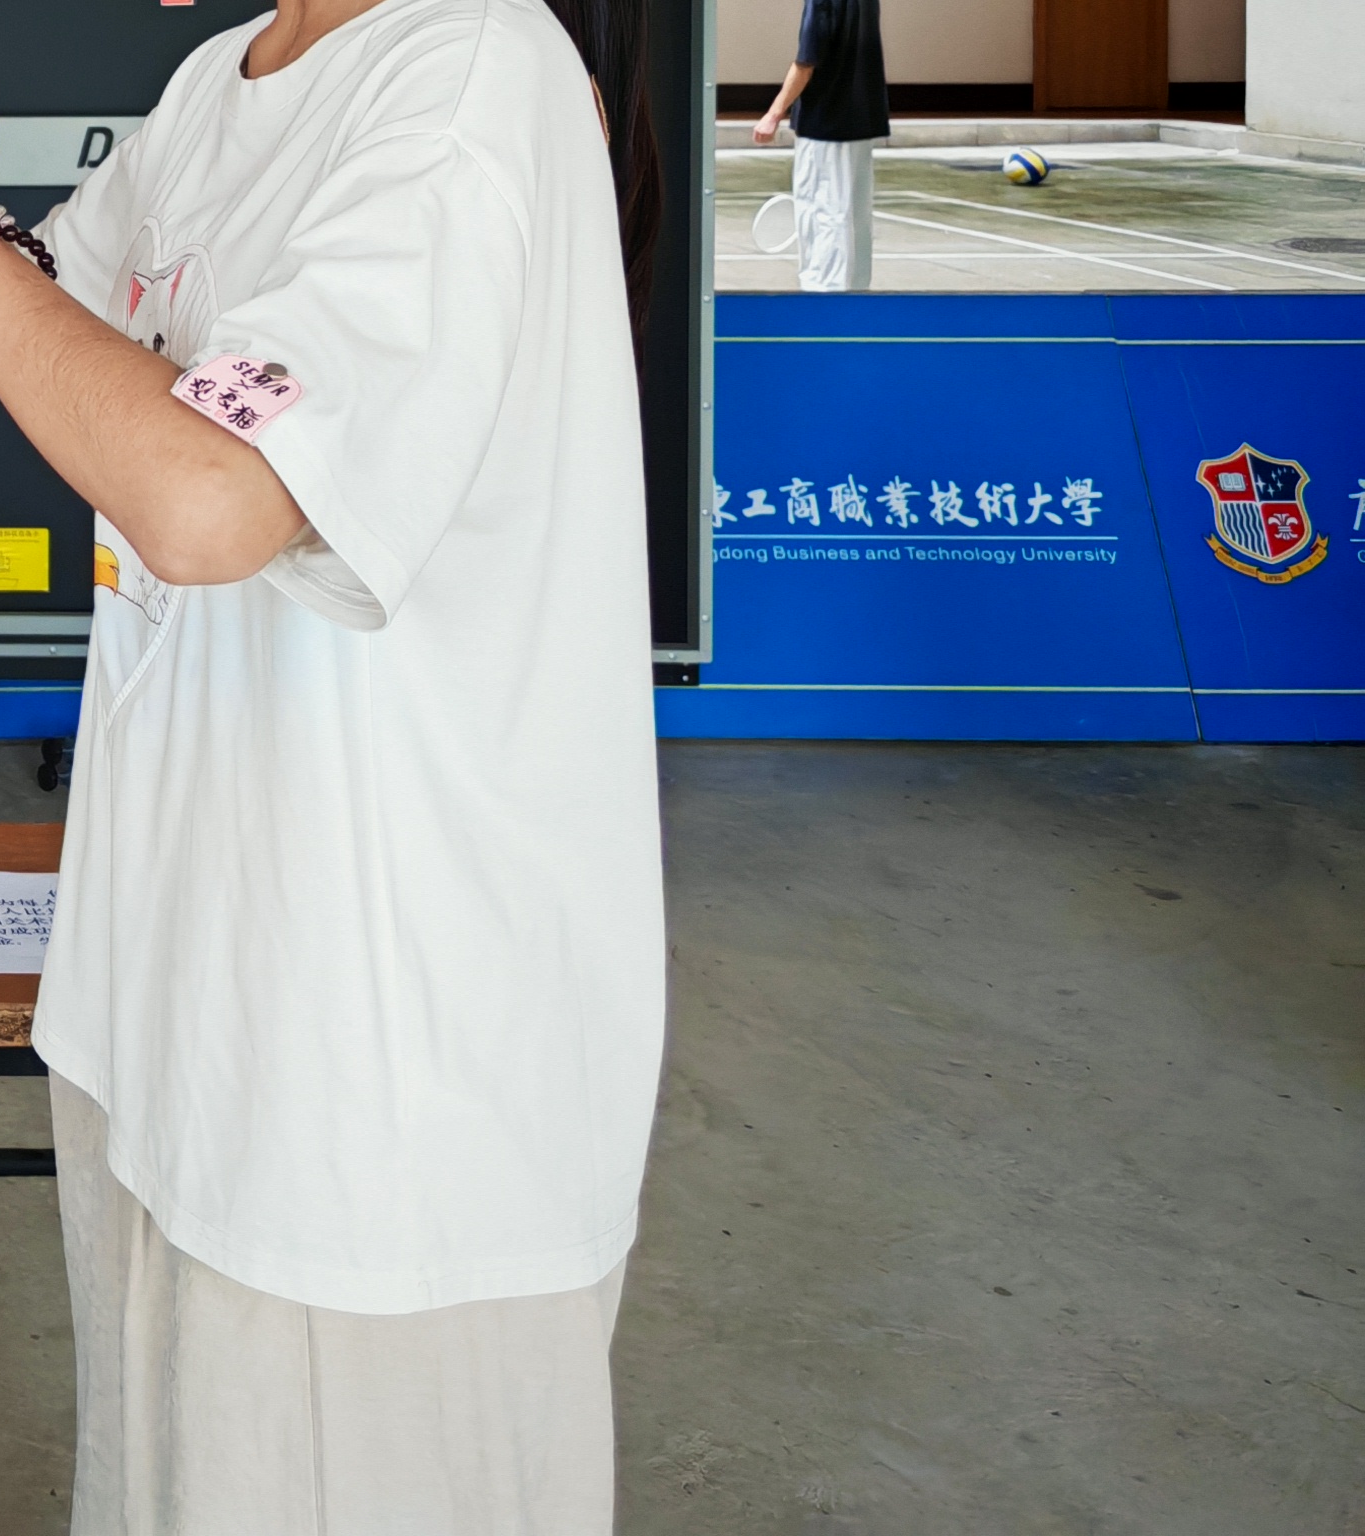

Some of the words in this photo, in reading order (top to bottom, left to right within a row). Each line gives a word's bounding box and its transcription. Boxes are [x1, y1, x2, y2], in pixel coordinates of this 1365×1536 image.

[232, 361, 290, 397] SEMIR
[772, 545, 859, 561] Business
[865, 547, 901, 561] and
[904, 546, 1016, 564] Technology
[1021, 547, 1117, 564] University
